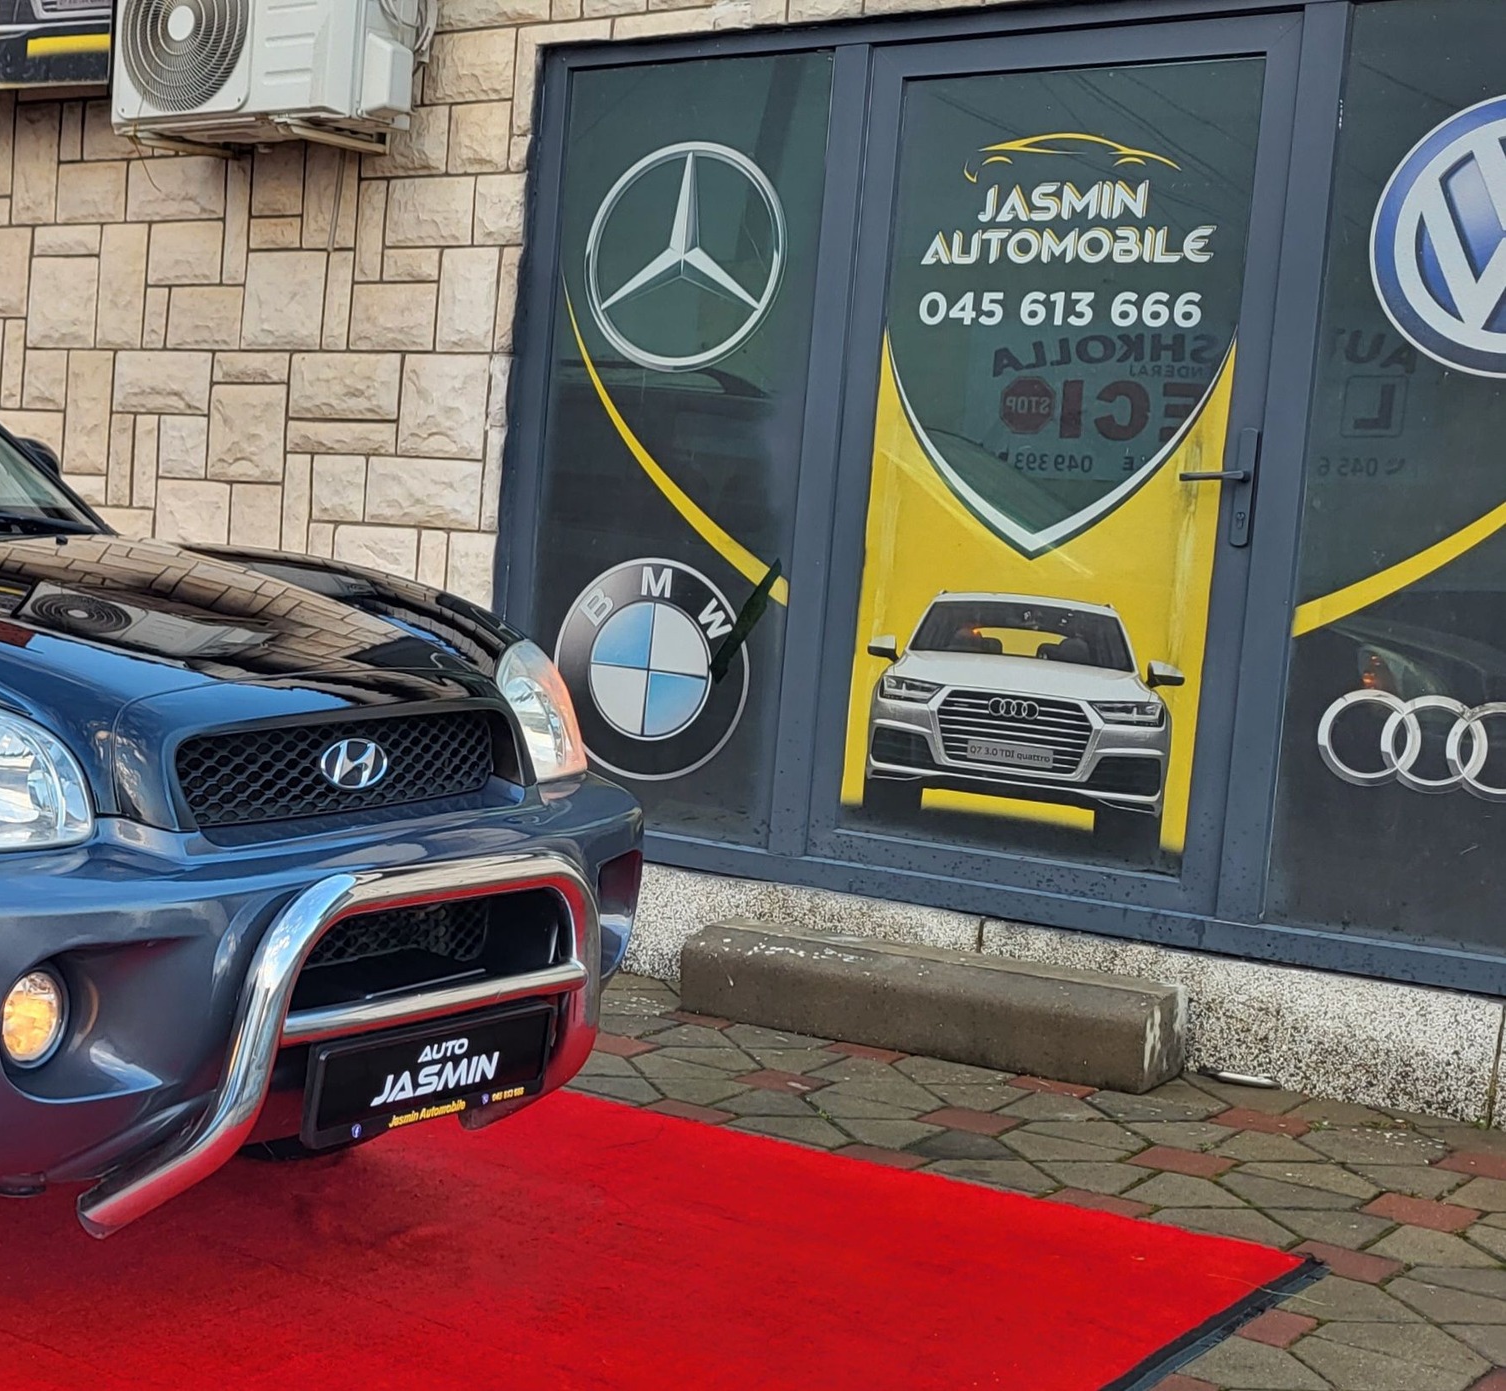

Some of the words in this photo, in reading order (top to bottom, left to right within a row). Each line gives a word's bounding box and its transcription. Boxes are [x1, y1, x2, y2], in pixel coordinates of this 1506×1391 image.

[977, 179, 1150, 222] JASMIN
[920, 225, 1218, 265] AUTOMOBILE
[919, 291, 1004, 326] 045
[1020, 291, 1095, 327] 613
[1110, 291, 1202, 328] 666
[579, 566, 733, 640] BMW
[1000, 749, 1014, 759] TDI
[1016, 751, 1051, 763] quattro
[417, 1037, 470, 1063] AUTO
[370, 1051, 500, 1107] JASMIN
[388, 1110, 419, 1128] Jasmin
[419, 1099, 467, 1121] Automobile
